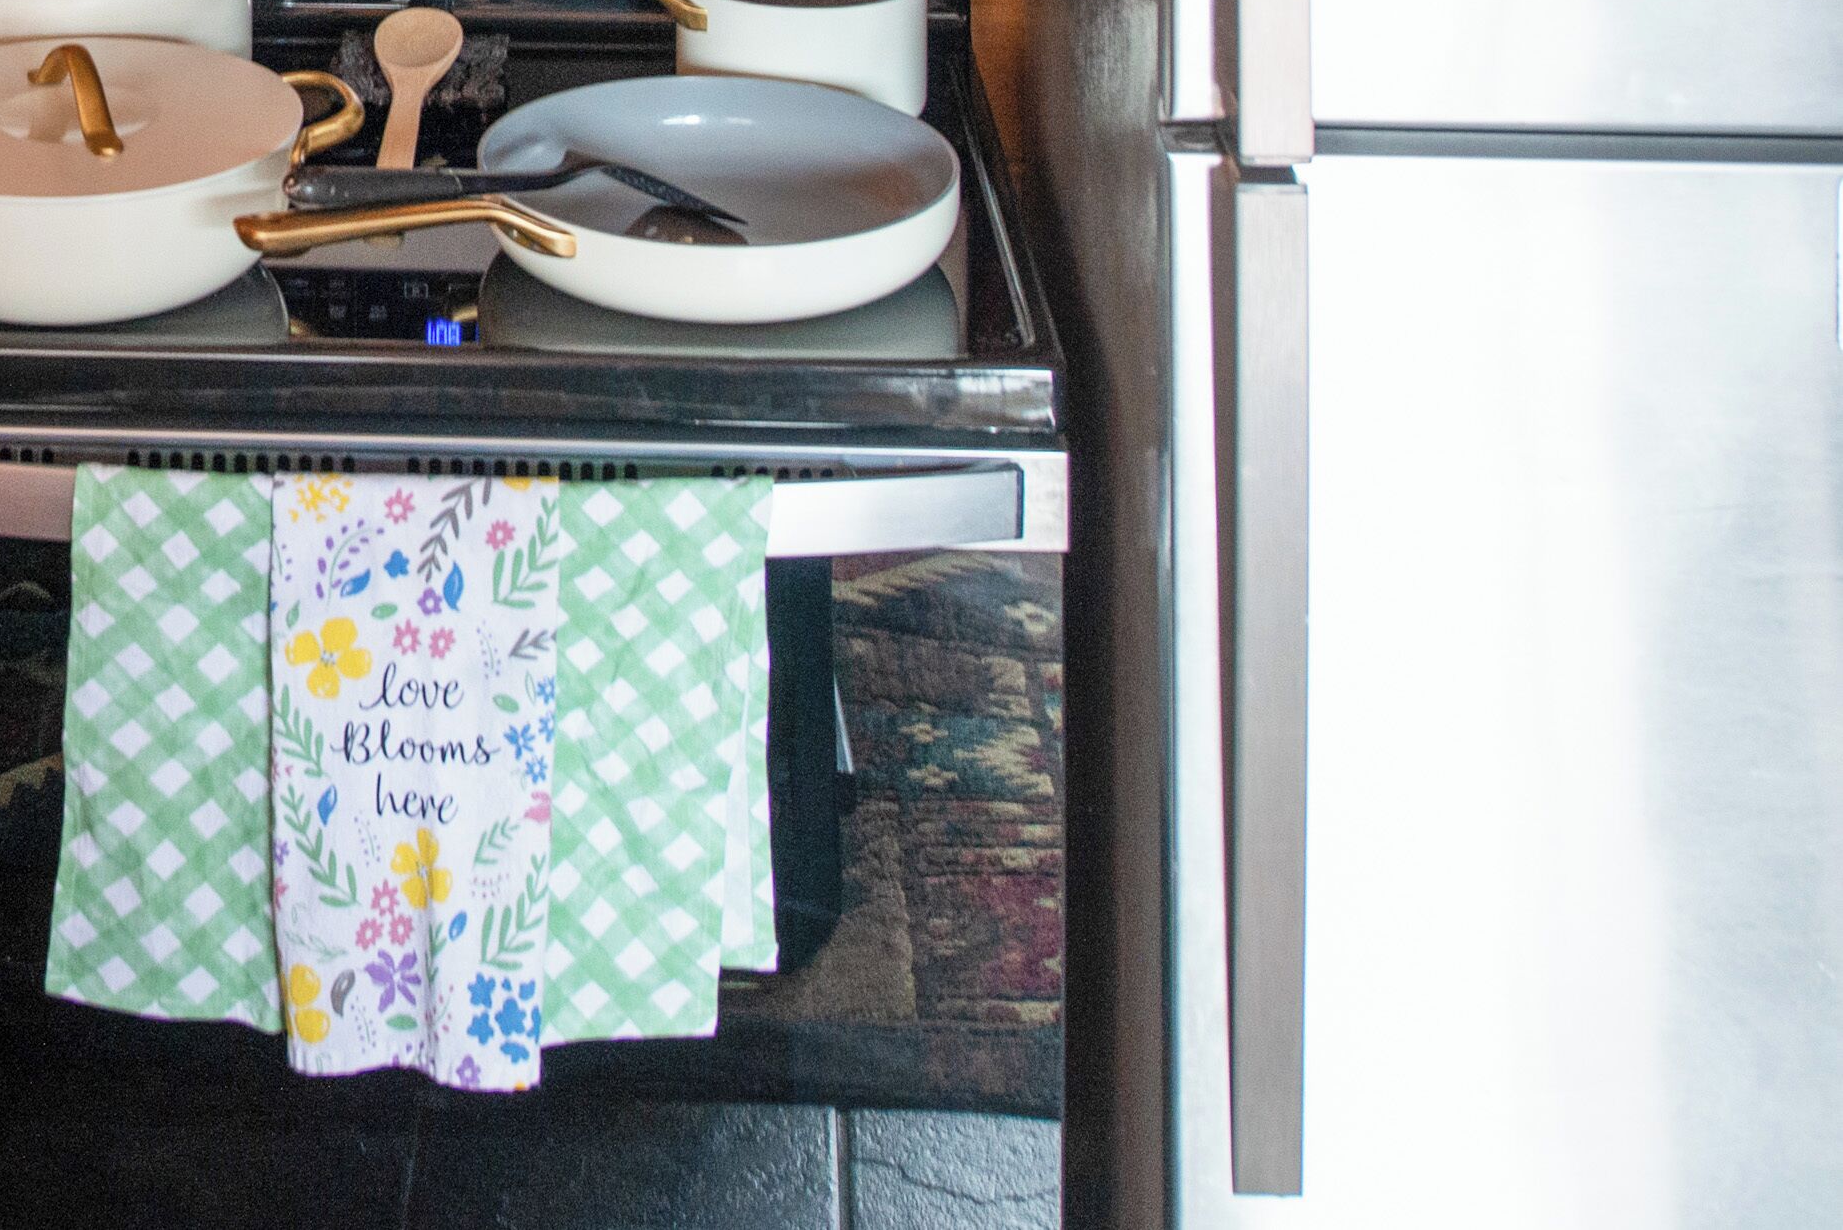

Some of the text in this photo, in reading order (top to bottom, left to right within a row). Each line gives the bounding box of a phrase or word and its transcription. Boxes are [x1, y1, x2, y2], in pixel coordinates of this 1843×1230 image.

[359, 662, 464, 710] love
[330, 719, 501, 765] Blooms
[374, 771, 458, 825] here
